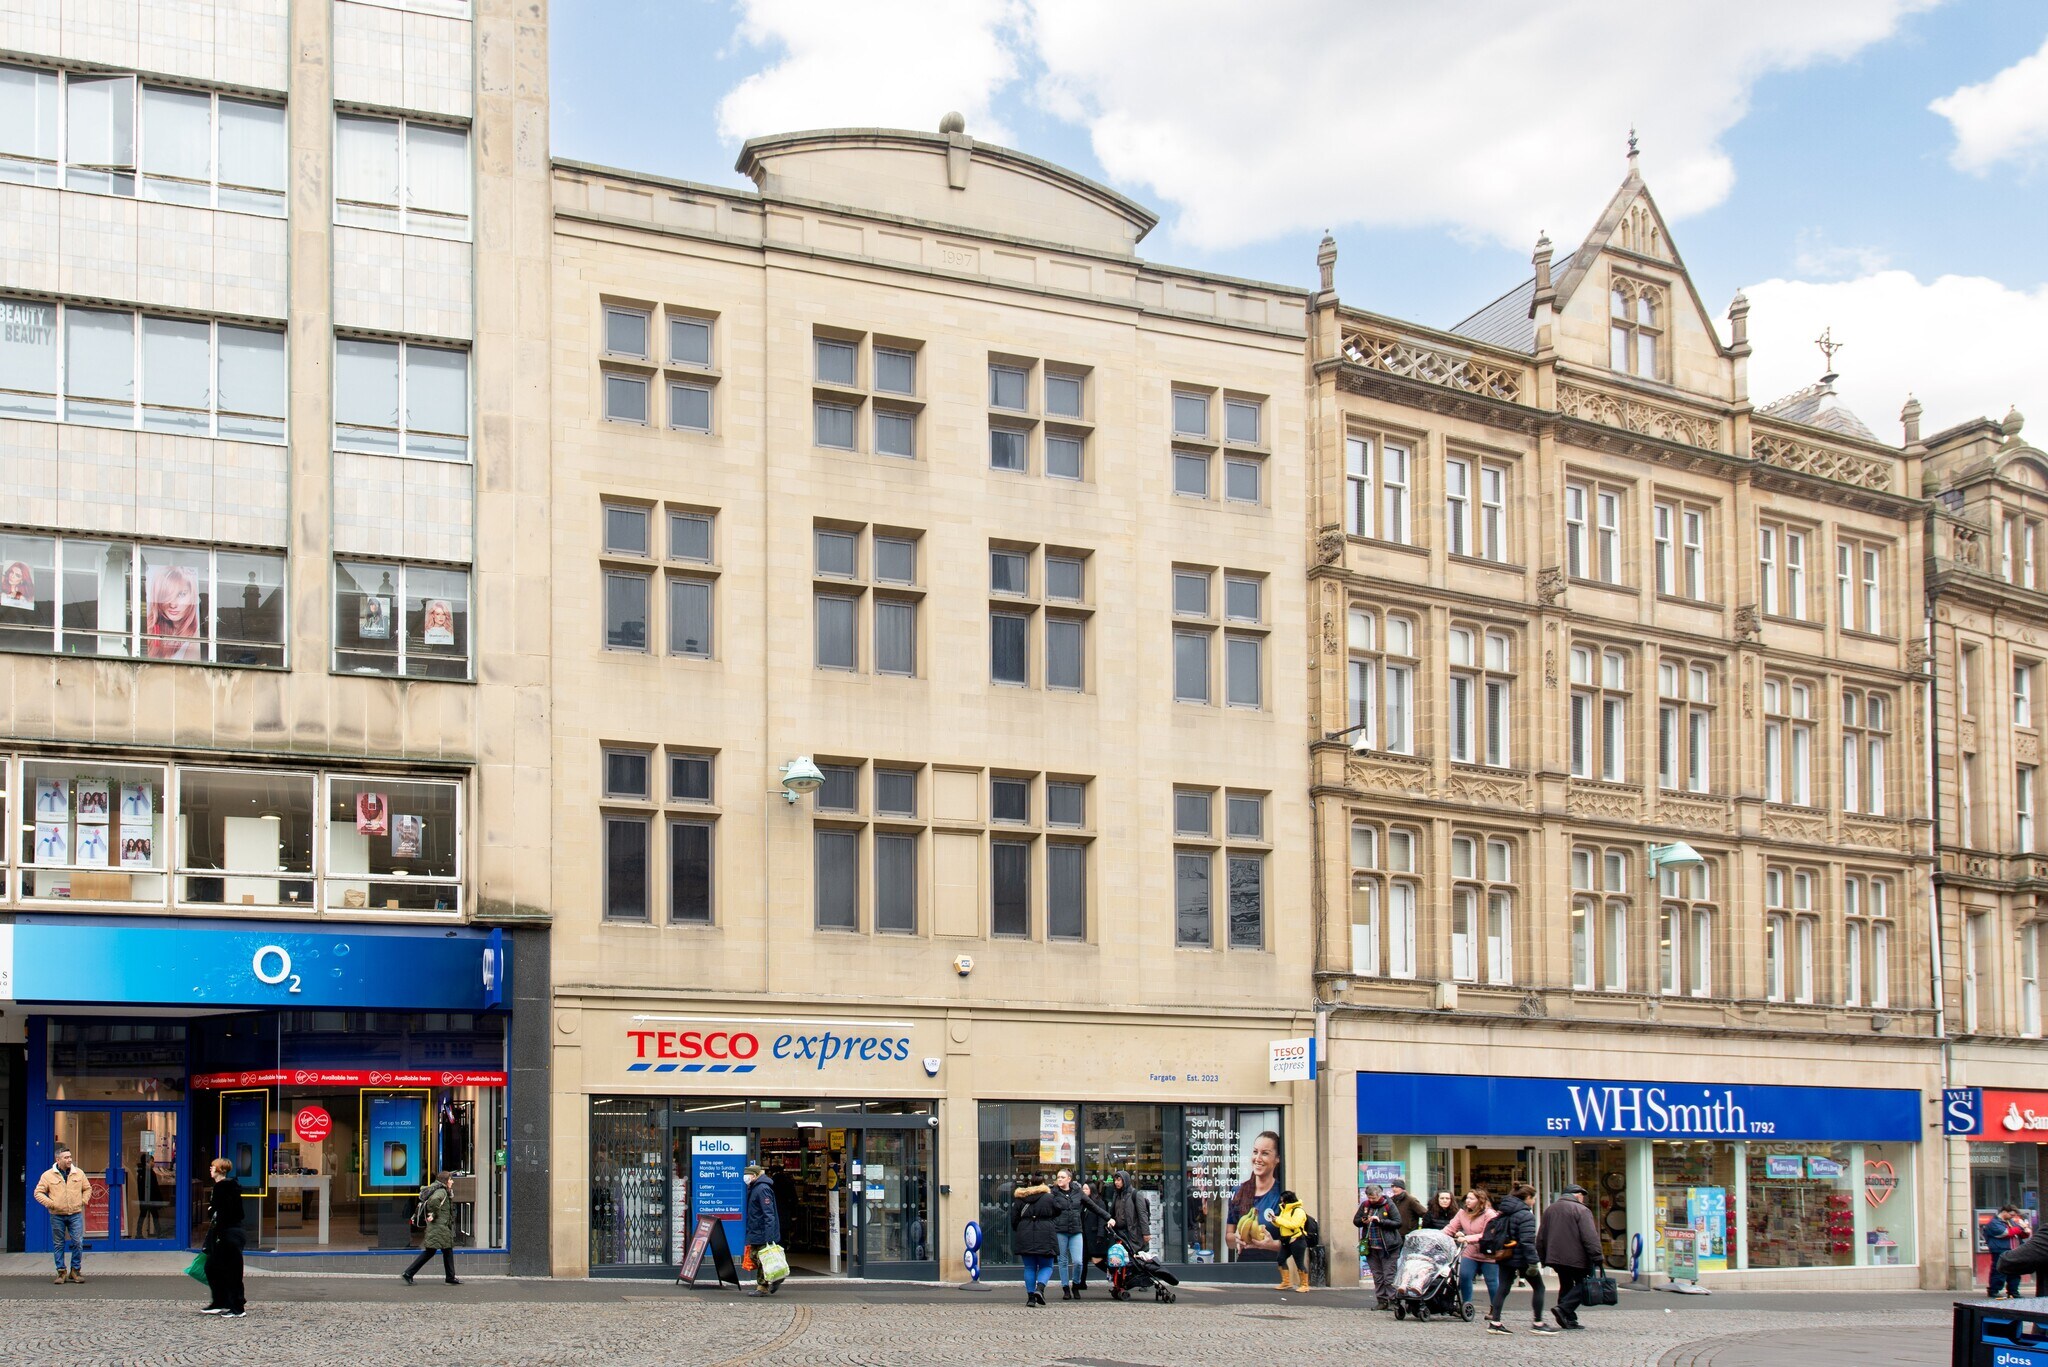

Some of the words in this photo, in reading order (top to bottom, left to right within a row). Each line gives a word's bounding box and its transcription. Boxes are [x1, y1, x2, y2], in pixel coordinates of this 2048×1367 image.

[943, 250, 972, 266] 1997
[0, 302, 45, 326] BEAUTY
[627, 1031, 759, 1059] TESCO
[773, 1031, 910, 1070] express
[1274, 1046, 1304, 1057] TESCO
[1273, 1060, 1305, 1072] express
[1150, 1073, 1176, 1082] Fargate
[1948, 1092, 1973, 1100] WH
[1547, 1118, 1571, 1130] EST
[1567, 1086, 1748, 1133] WHSmith
[1750, 1122, 1775, 1133] 1792
[1948, 1100, 1975, 1132] S
[1191, 1118, 1225, 1130] Serving
[1192, 1130, 1240, 1139] Sheffield's
[700, 1140, 733, 1151] Hello.
[722, 1171, 739, 1179] 11pm
[1192, 1165, 1209, 1174] and
[1212, 1165, 1240, 1177] planet
[1192, 1177, 1213, 1186] little
[1215, 1177, 1242, 1187] better
[1193, 1190, 1218, 1200] every
[1220, 1189, 1236, 1200] day
[1701, 1195, 1708, 1210] 3
[1716, 1195, 1725, 1210] 2
[1997, 1353, 2032, 1365] glass
